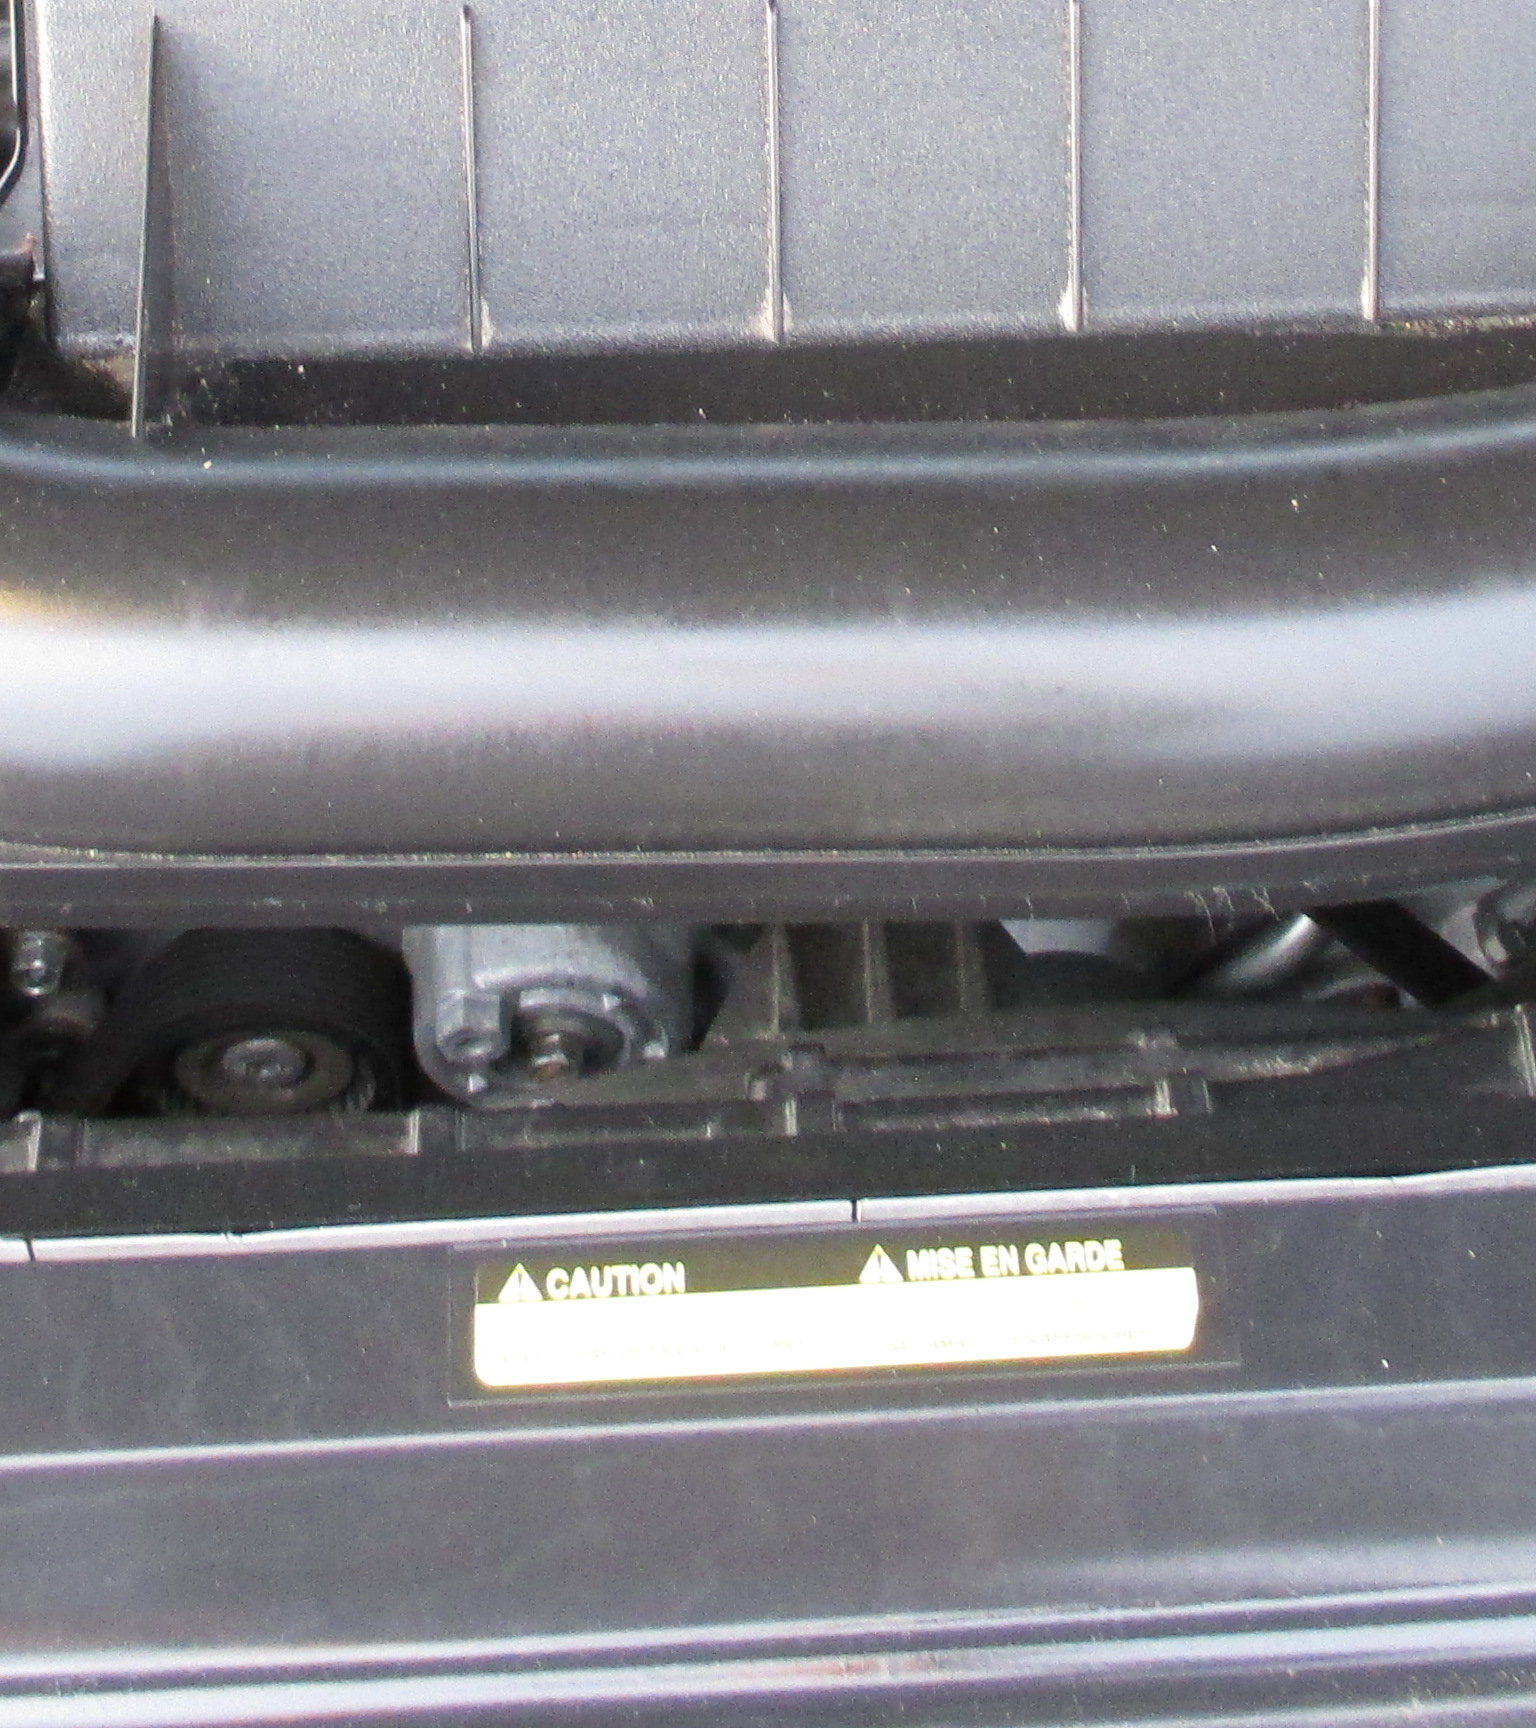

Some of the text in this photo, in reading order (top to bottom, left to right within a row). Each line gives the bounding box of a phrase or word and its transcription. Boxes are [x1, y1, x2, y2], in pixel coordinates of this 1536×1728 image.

[546, 1261, 686, 1300] CAUTION
[905, 1238, 1125, 1282] MISE EN GARDE
